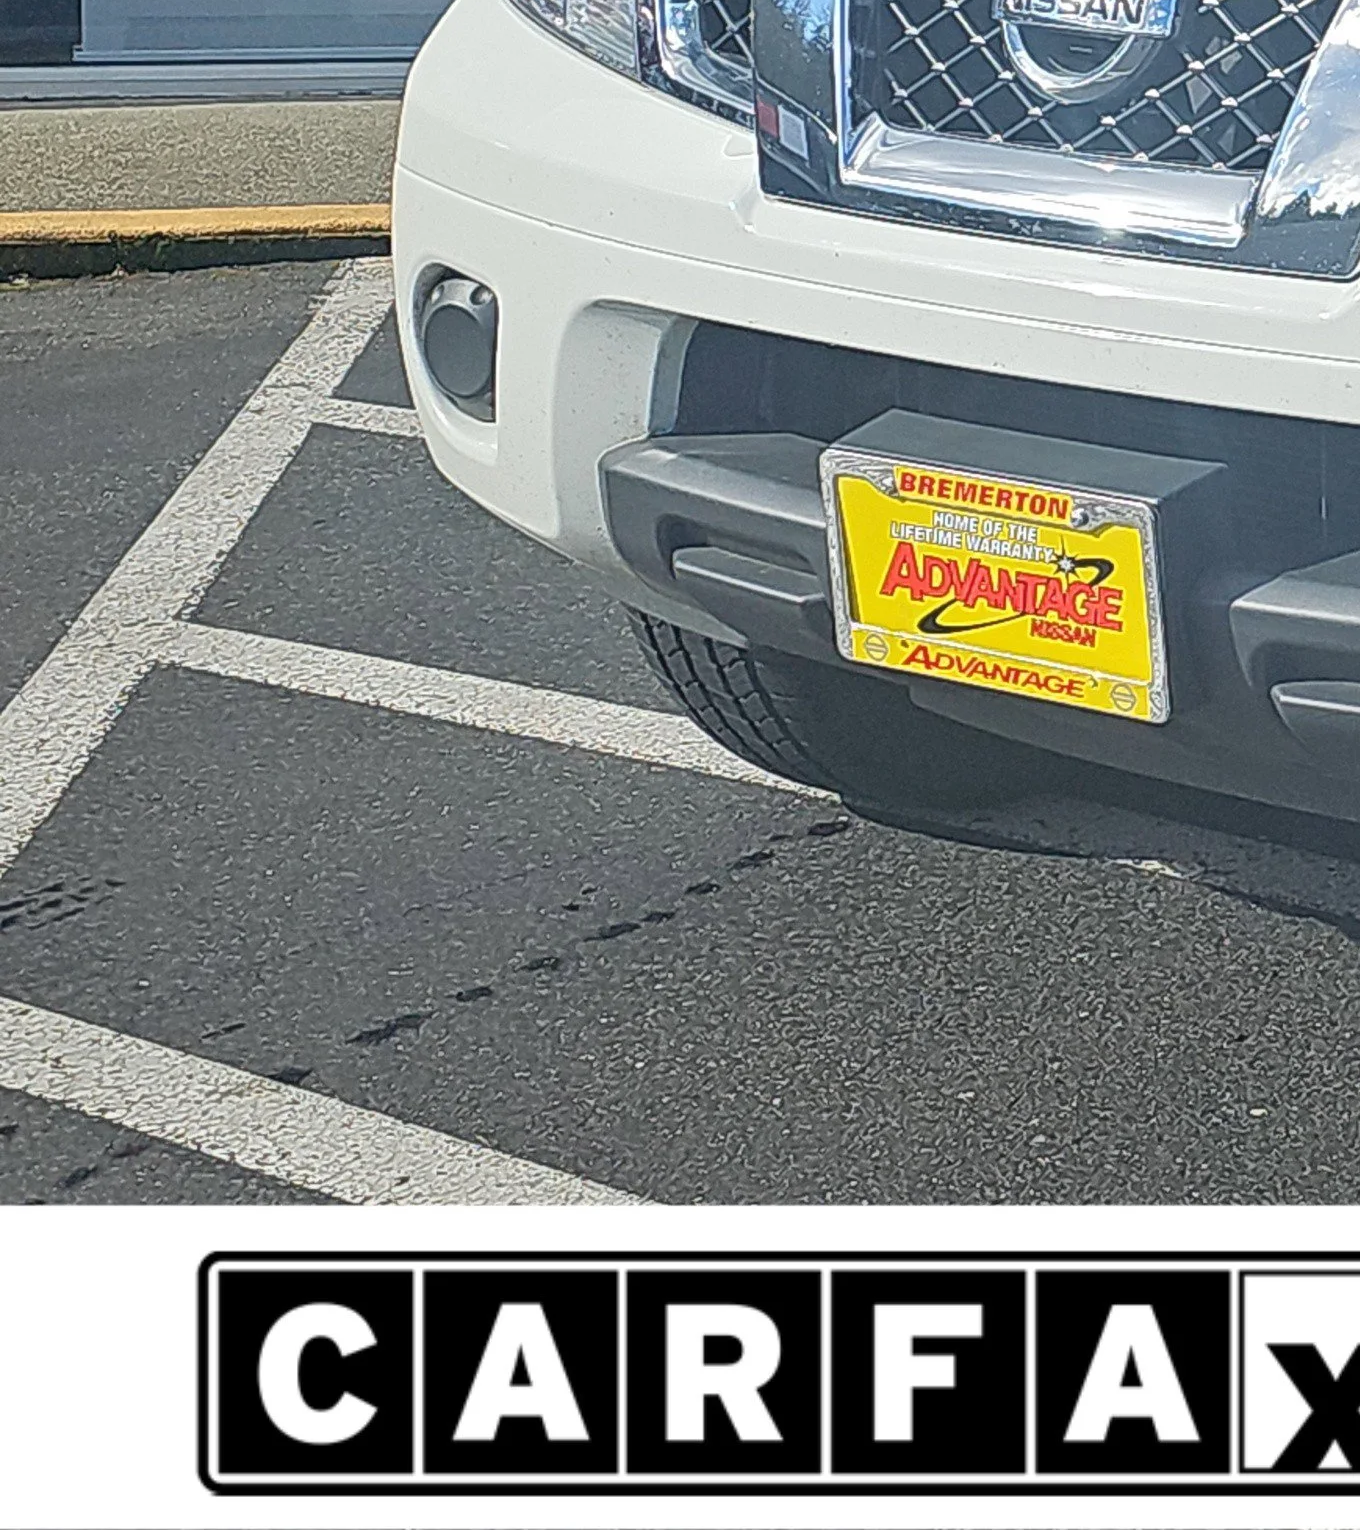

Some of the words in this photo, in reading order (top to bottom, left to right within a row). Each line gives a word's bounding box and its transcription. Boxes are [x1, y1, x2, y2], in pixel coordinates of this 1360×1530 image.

[899, 471, 1070, 520] BREMERTON
[890, 522, 962, 549] LIFETIME
[966, 535, 1054, 564] WARRANTY
[933, 511, 978, 534] HOME
[982, 517, 1003, 537] OF
[1008, 521, 1038, 542] THE
[880, 541, 1124, 632] ADVANTAGE
[1030, 618, 1097, 647] NISSAN
[901, 644, 1088, 699] ADVANTAGE
